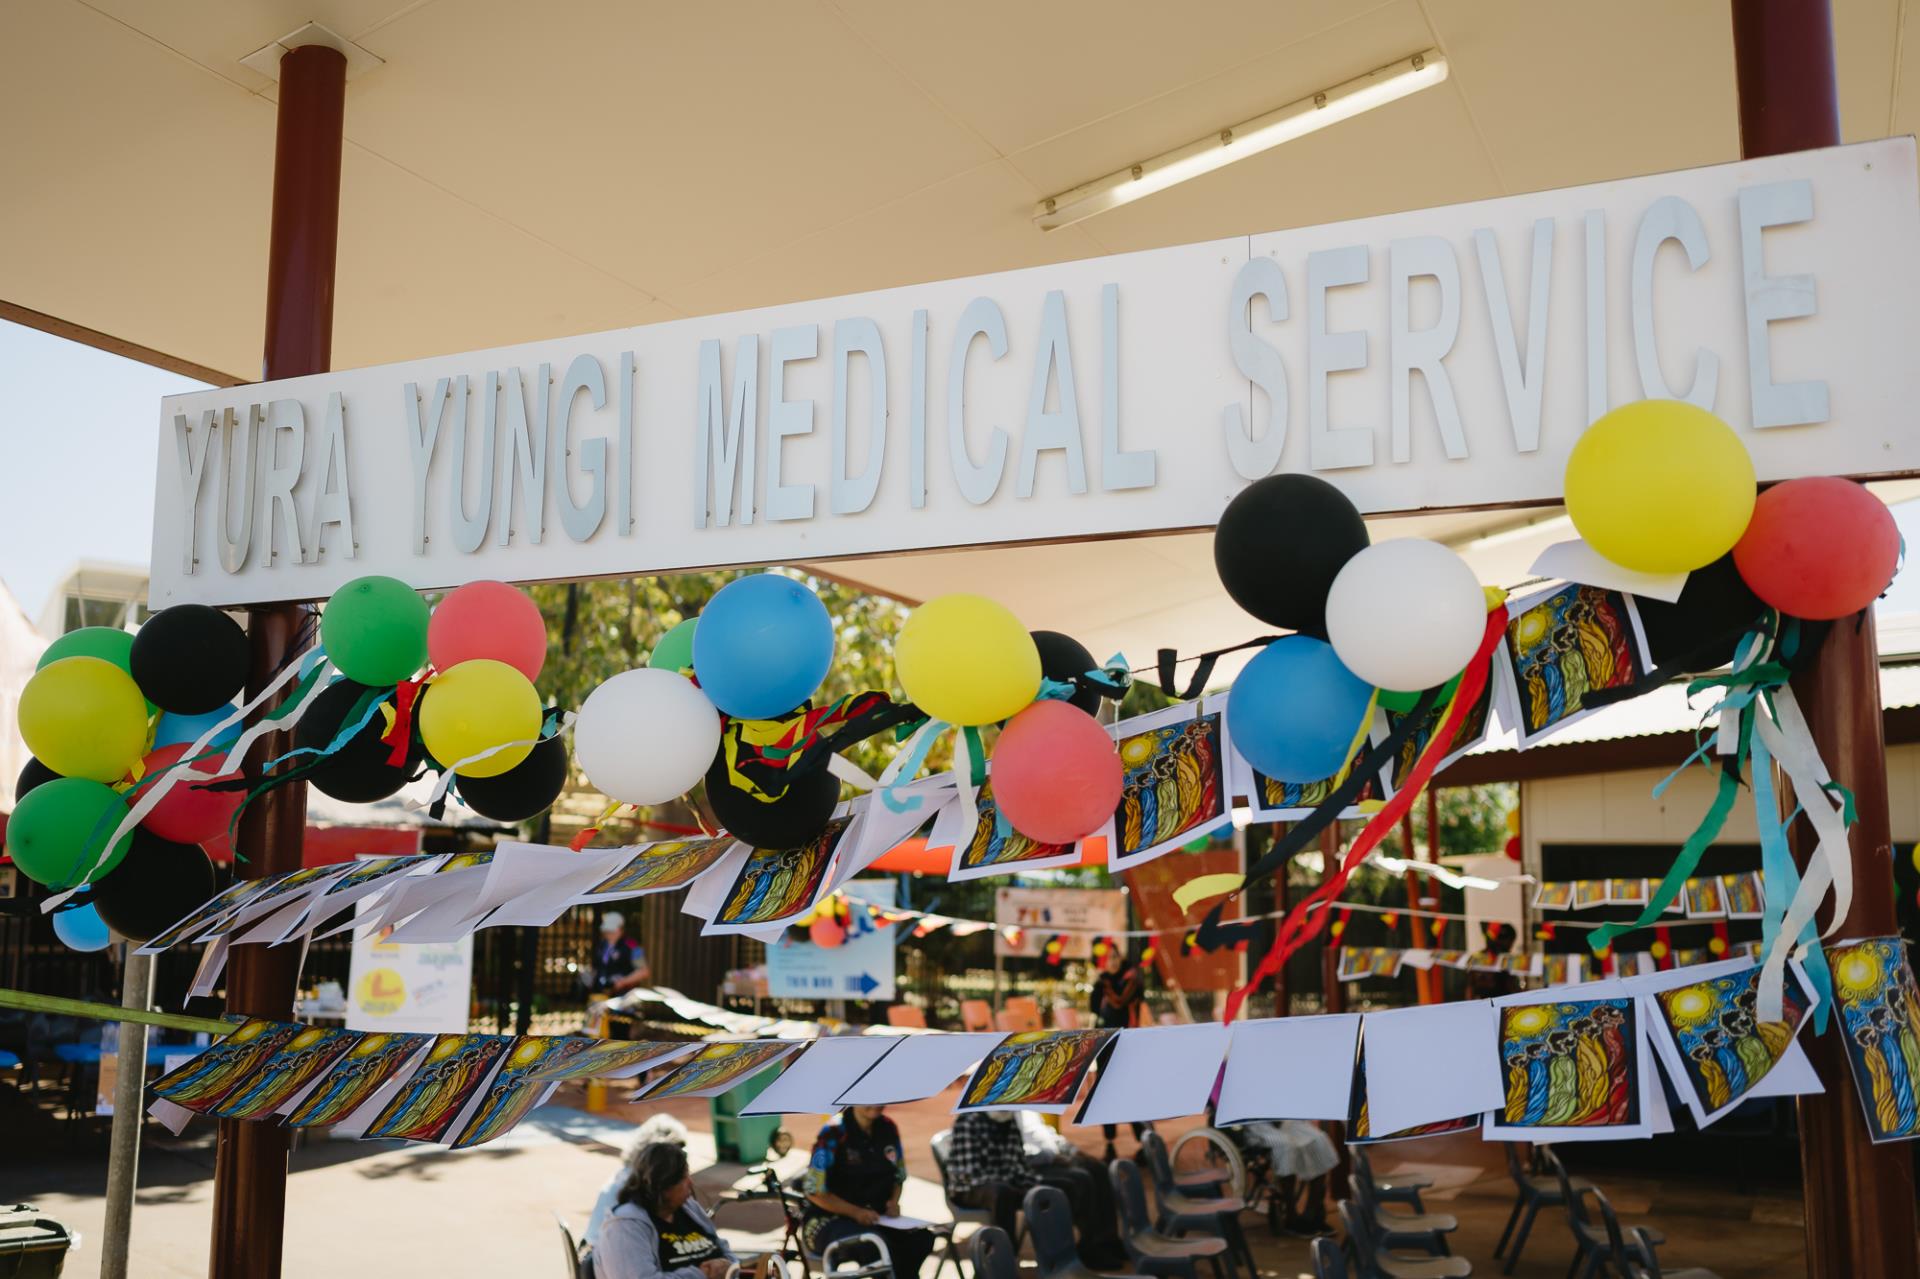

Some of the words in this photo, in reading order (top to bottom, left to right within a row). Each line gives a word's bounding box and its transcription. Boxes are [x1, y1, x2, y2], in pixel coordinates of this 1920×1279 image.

[173, 391, 358, 575] YURA
[404, 350, 635, 555] YUNGI
[694, 282, 1157, 529] MEDICAL
[1222, 178, 1831, 481] SERVICE
